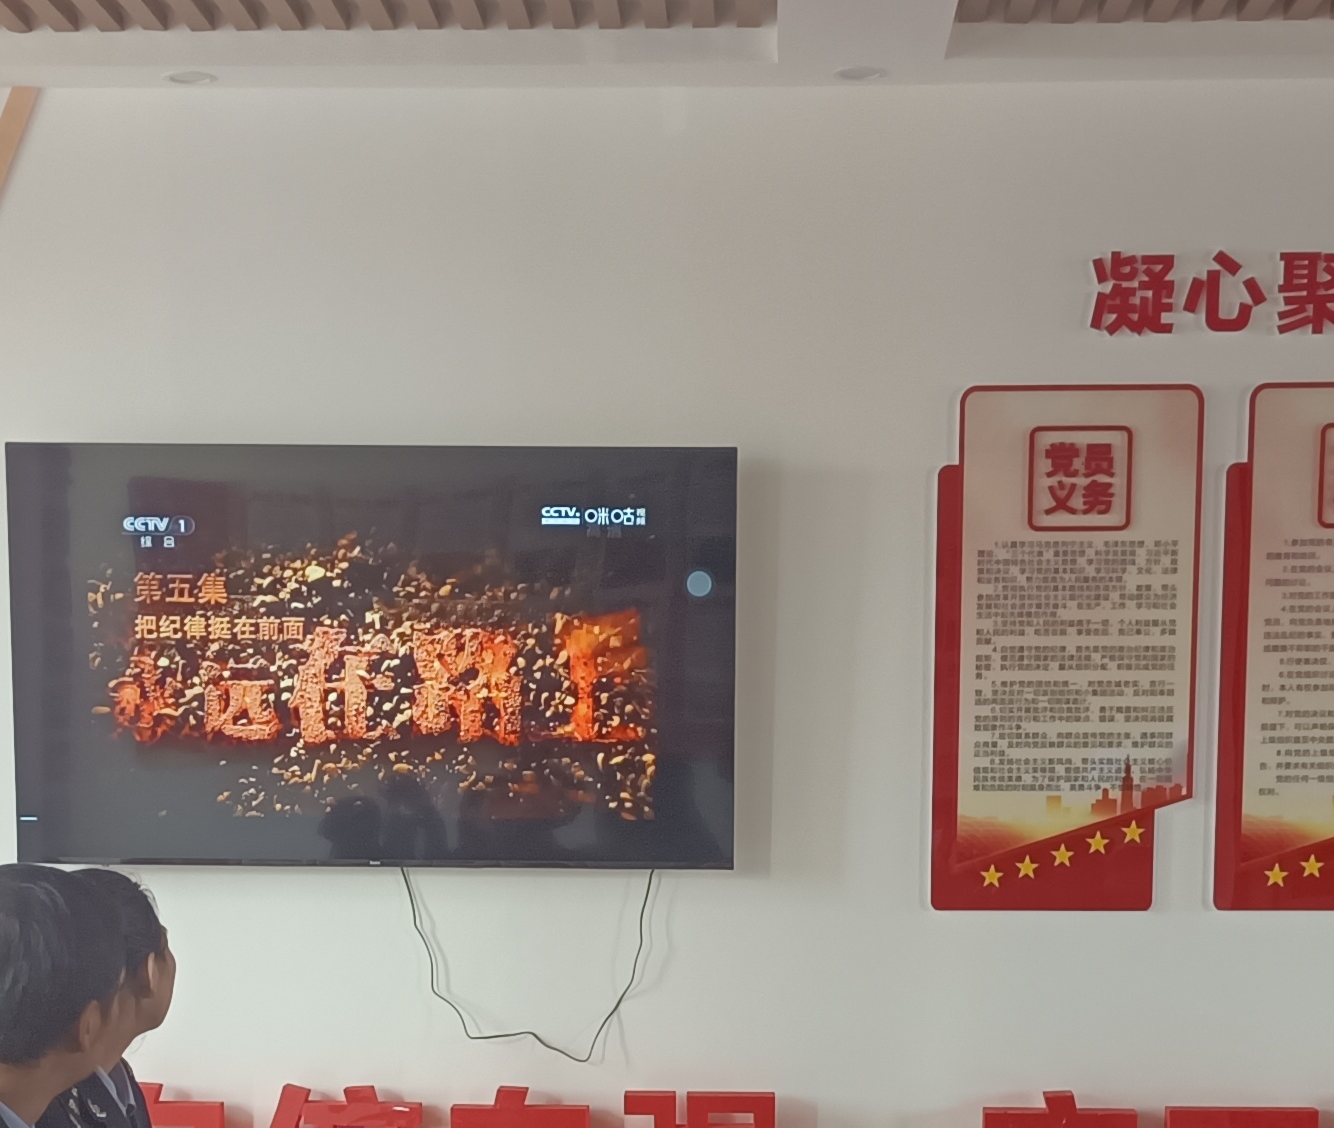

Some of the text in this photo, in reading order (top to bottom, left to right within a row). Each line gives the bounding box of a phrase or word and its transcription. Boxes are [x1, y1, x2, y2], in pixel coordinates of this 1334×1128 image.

[1044, 442, 1116, 478] 党员
[1044, 480, 1116, 516] 义务
[123, 516, 169, 532] CCTV
[134, 571, 228, 605] 第五集
[134, 614, 306, 641] 把纪律挺在前面
